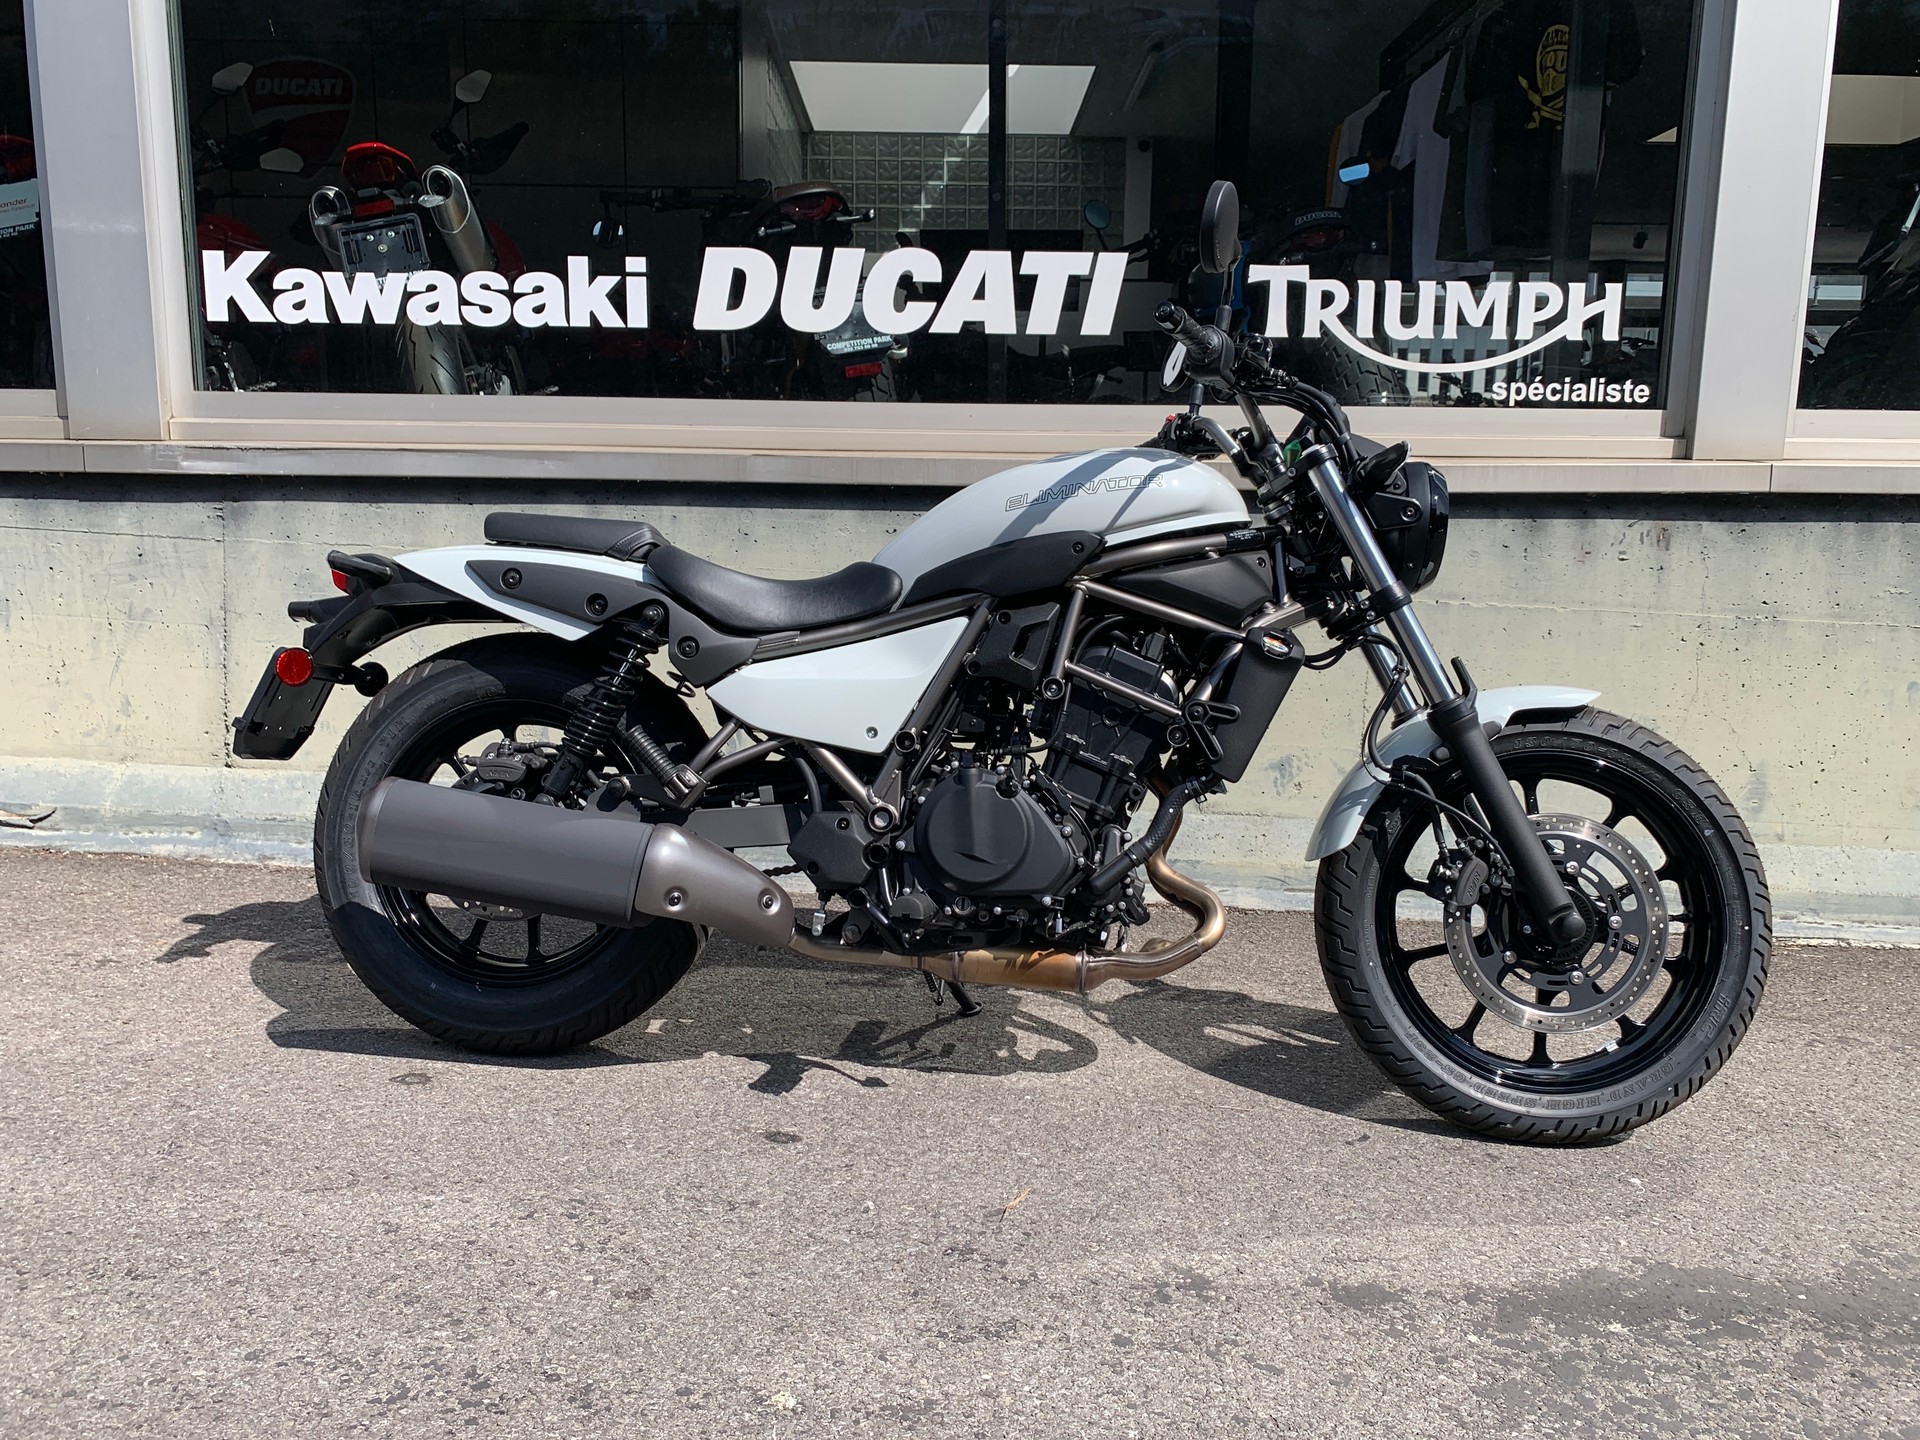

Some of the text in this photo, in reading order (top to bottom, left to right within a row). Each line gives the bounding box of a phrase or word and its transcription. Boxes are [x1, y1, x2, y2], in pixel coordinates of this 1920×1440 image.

[255, 77, 344, 96] DUCATI
[202, 249, 649, 329] Kawasaki
[693, 246, 1129, 336] DUCATI
[1248, 264, 1623, 373] TRIUMPH
[826, 337, 873, 351] COMPETITION
[873, 335, 893, 344] PARK
[1491, 376, 1651, 407] spécialiste
[1005, 474, 1164, 512] ELIMINATOR
[1470, 1081, 1538, 1109] SPEED
[1607, 1060, 1676, 1105] GRAND
[1544, 1093, 1602, 1112] HIGH
